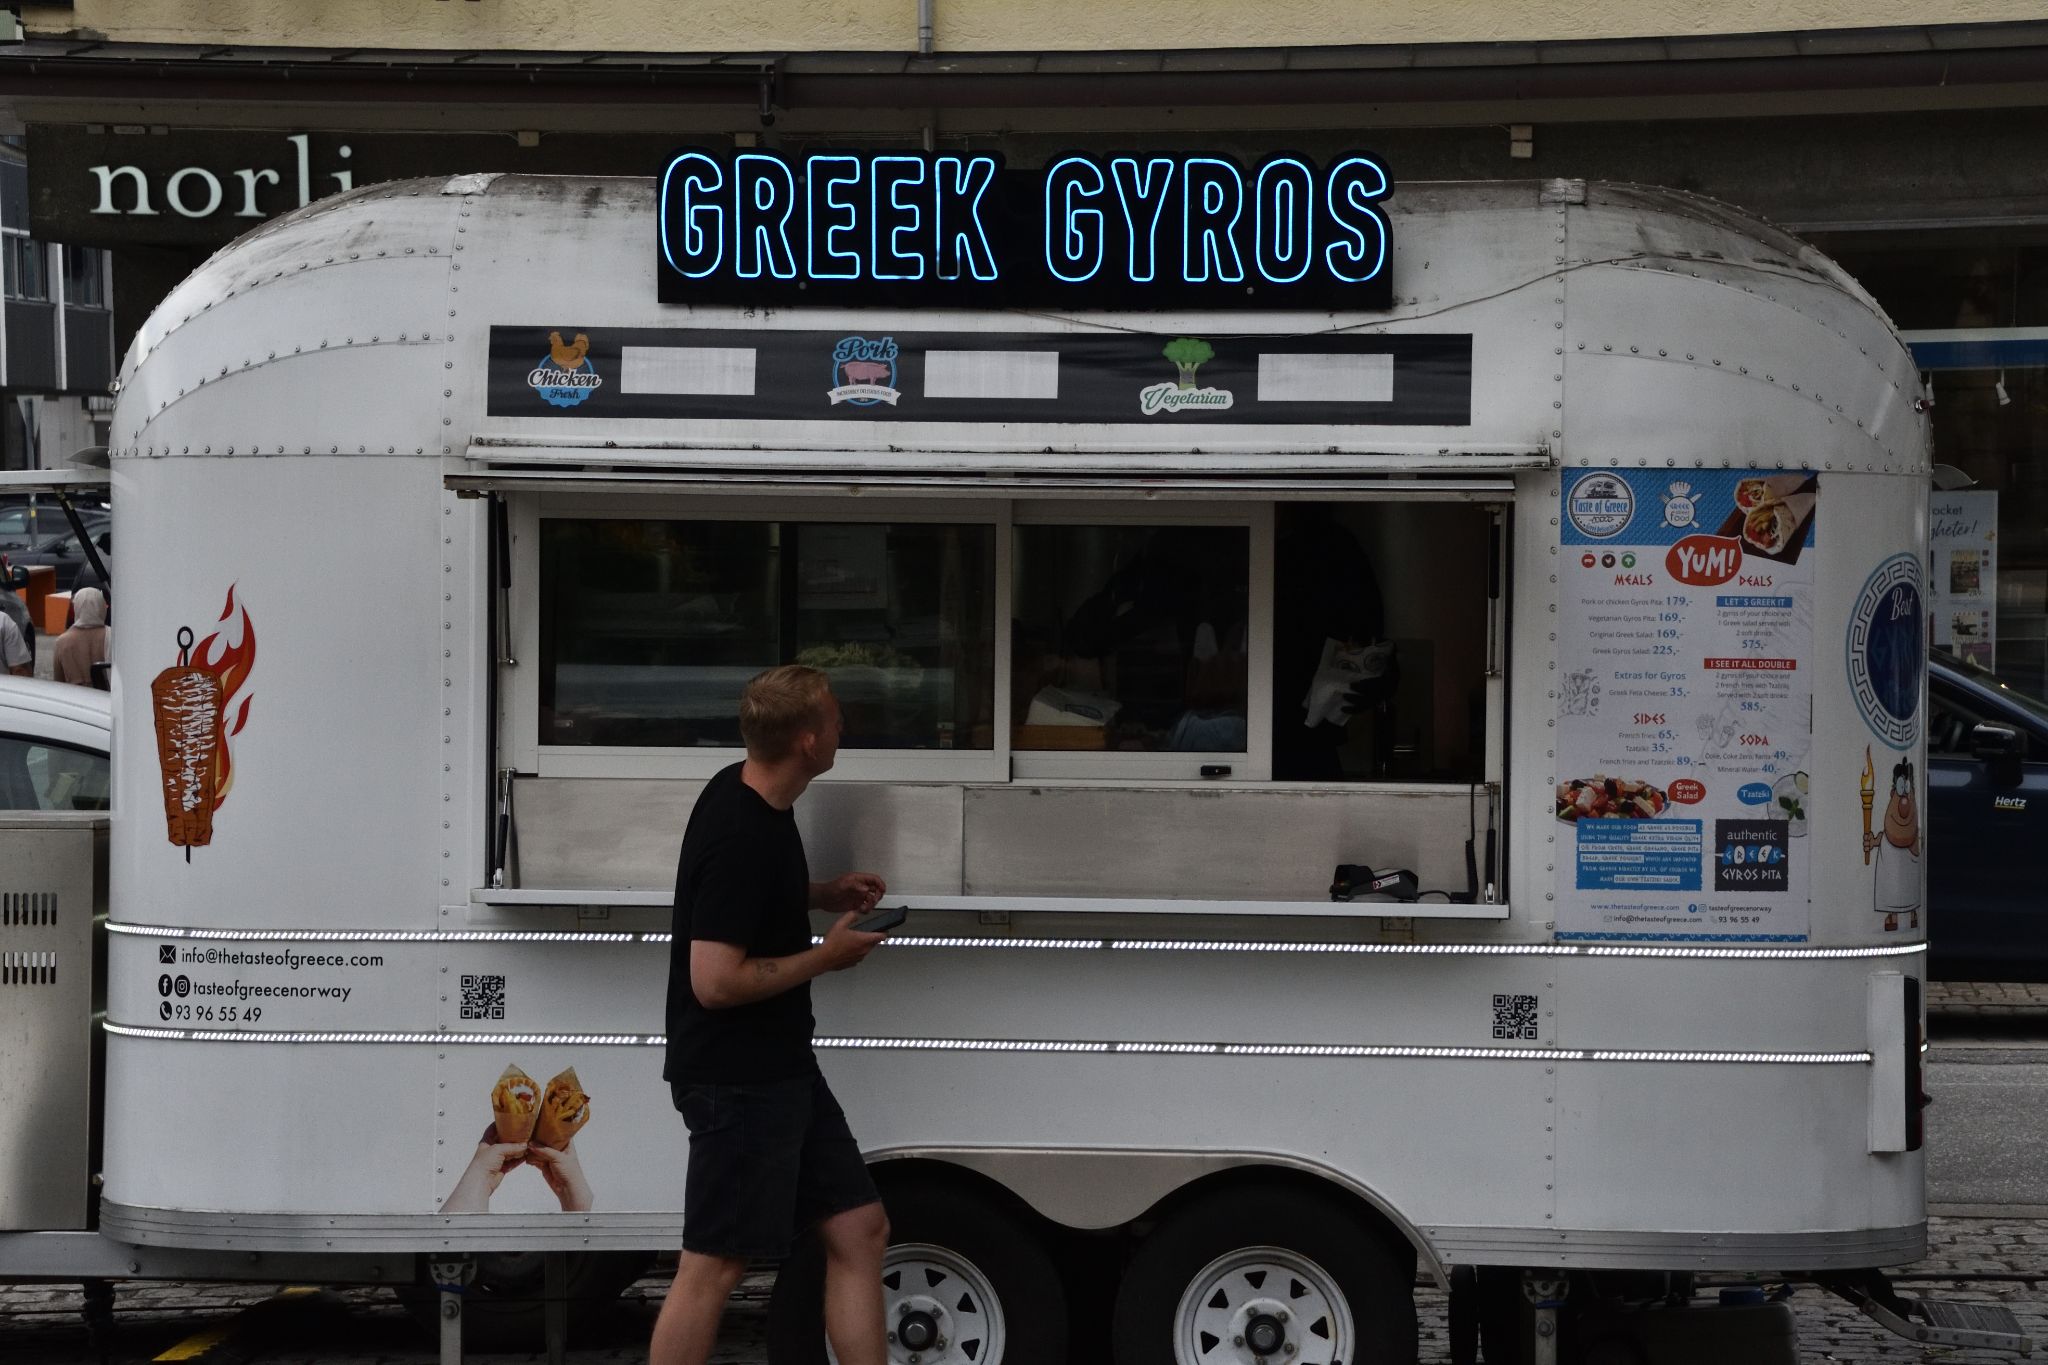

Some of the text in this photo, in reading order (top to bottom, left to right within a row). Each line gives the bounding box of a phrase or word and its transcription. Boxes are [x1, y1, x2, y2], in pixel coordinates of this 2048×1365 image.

[89, 134, 352, 218] norli
[662, 152, 1388, 284] GREEK GYROS
[834, 337, 898, 360] Pork
[529, 368, 602, 387] Chicken
[550, 389, 579, 399] Fresh
[1144, 388, 1226, 410] Vegetarian
[1574, 500, 1627, 514] Taste of Greece
[1670, 511, 1690, 521] food
[1614, 574, 1653, 586] MEALS
[1739, 576, 1773, 587] DEALS
[1631, 599, 1649, 607] Gyros
[1666, 597, 1694, 607] 179,-
[1750, 598, 1776, 606] GREEK
[1889, 587, 1914, 621] Best
[1659, 613, 1686, 623] 169,-
[1657, 629, 1684, 640] 169,-
[1742, 640, 1768, 650] 575,-
[1652, 646, 1680, 656] 225,-
[1758, 661, 1791, 669] DOUBLE
[1615, 671, 1686, 682] Extras for Gyros
[1670, 687, 1690, 698] 35,-
[1740, 702, 1766, 712] 585,-
[1634, 713, 1665, 724] SIDES
[1658, 730, 1680, 740] 65,-
[1740, 734, 1769, 746] SODA
[1652, 743, 1672, 753] 35,-
[1677, 756, 1697, 767] 89,-
[1773, 751, 1792, 761] 49,-
[1762, 764, 1780, 774] 40,-
[1676, 782, 1699, 791] Greek
[1676, 791, 1699, 800] Salad
[1995, 796, 2027, 807] Hertz
[1727, 829, 1778, 841] authentic
[1724, 847, 1780, 861] GREEK
[1722, 868, 1782, 880] GYROS PITA
[1590, 903, 1772, 913] www.thetasteofgreece.com tasteofgreecenorway
[1613, 915, 1702, 924] info@thetasteofgreece.com
[181, 948, 383, 970] info@thetasteofgreece.com
[193, 980, 352, 1002] tasteofgreecenorway
[176, 1006, 262, 1022] 93 96 55 49
